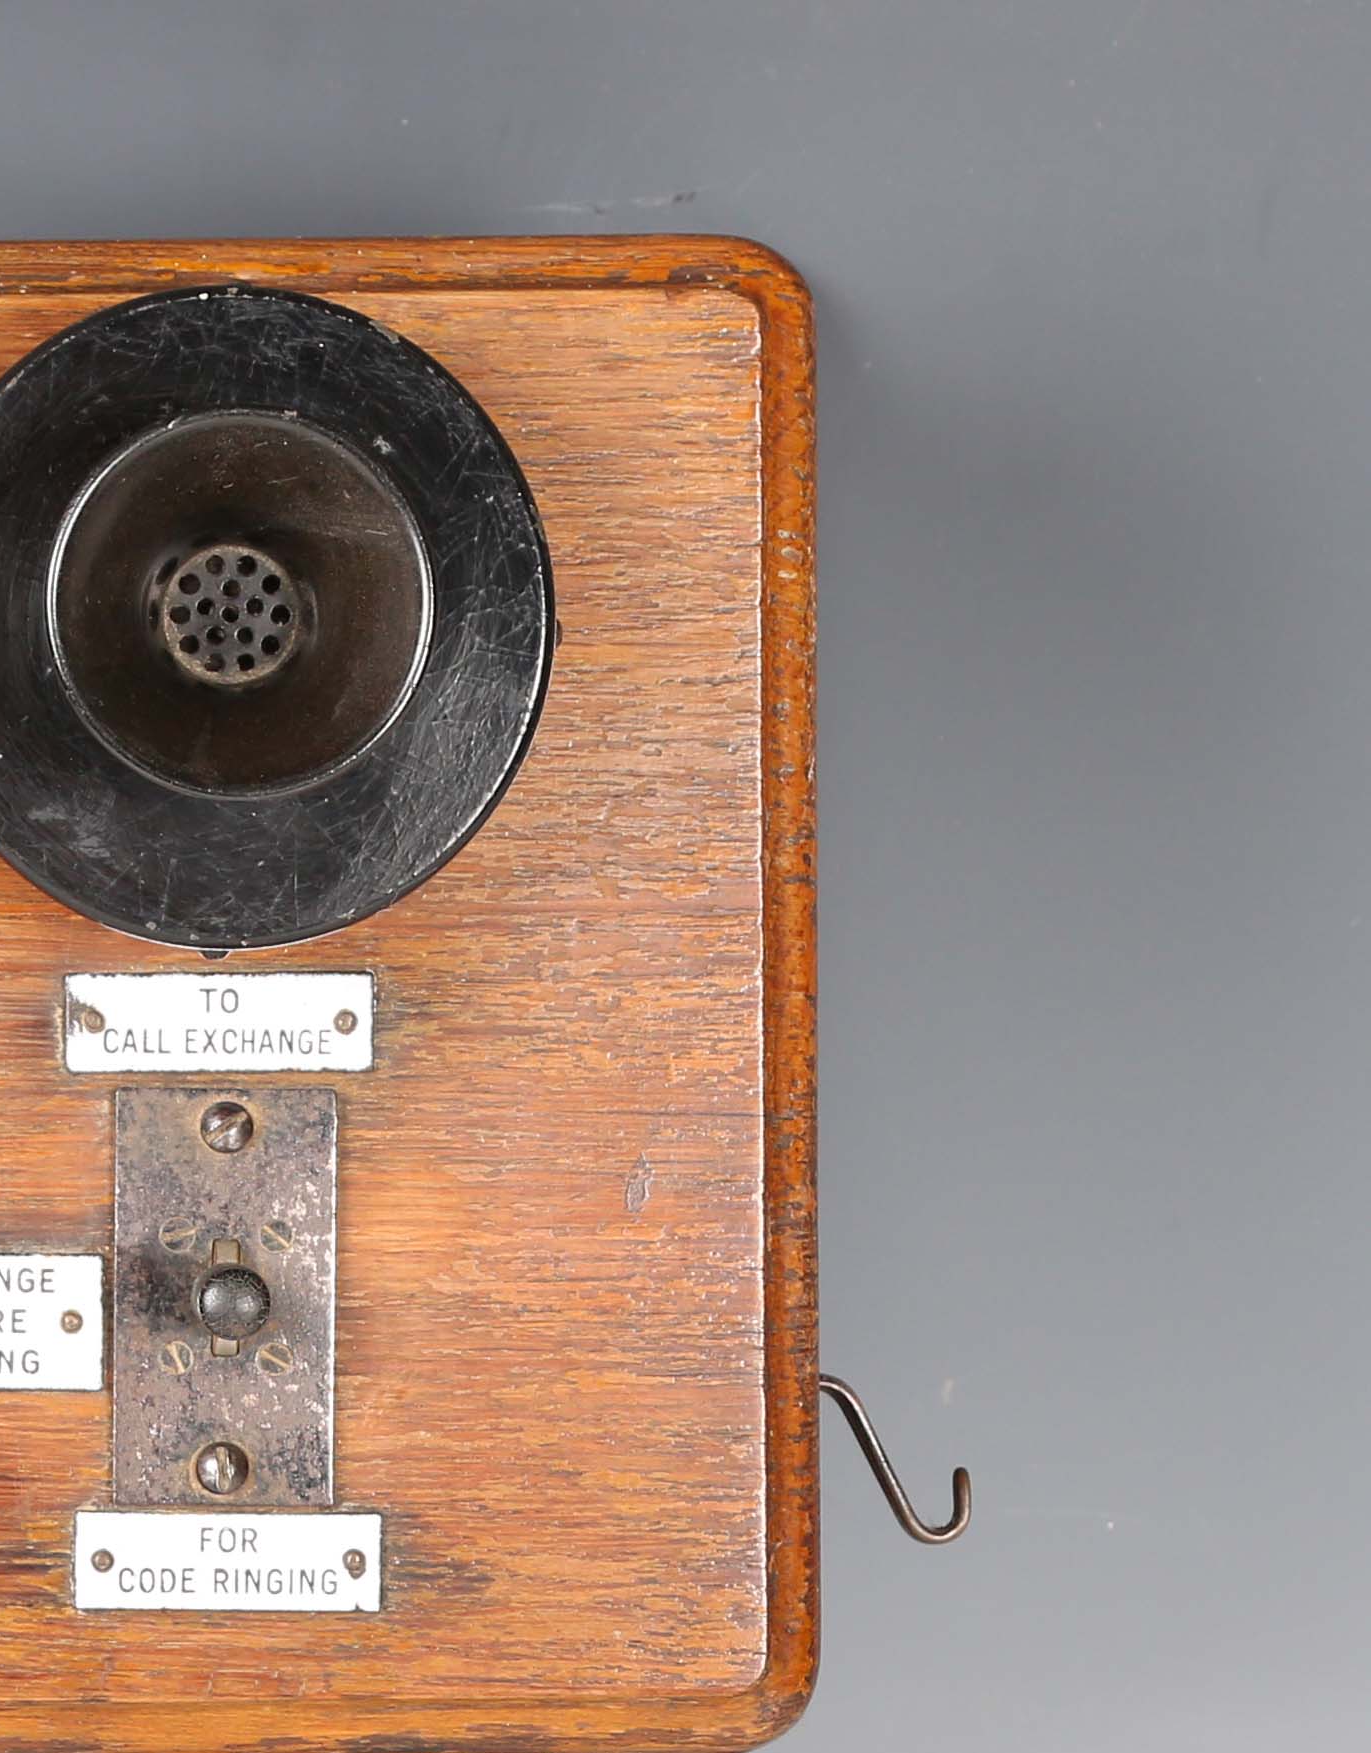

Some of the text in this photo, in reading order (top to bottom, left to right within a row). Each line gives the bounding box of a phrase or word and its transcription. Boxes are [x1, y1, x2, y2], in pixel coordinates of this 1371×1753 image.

[199, 988, 240, 1014] TO
[102, 1028, 332, 1055] CALL EXCHANGE
[200, 1526, 258, 1553] FOR
[118, 1567, 338, 1595] CODE RINGING
